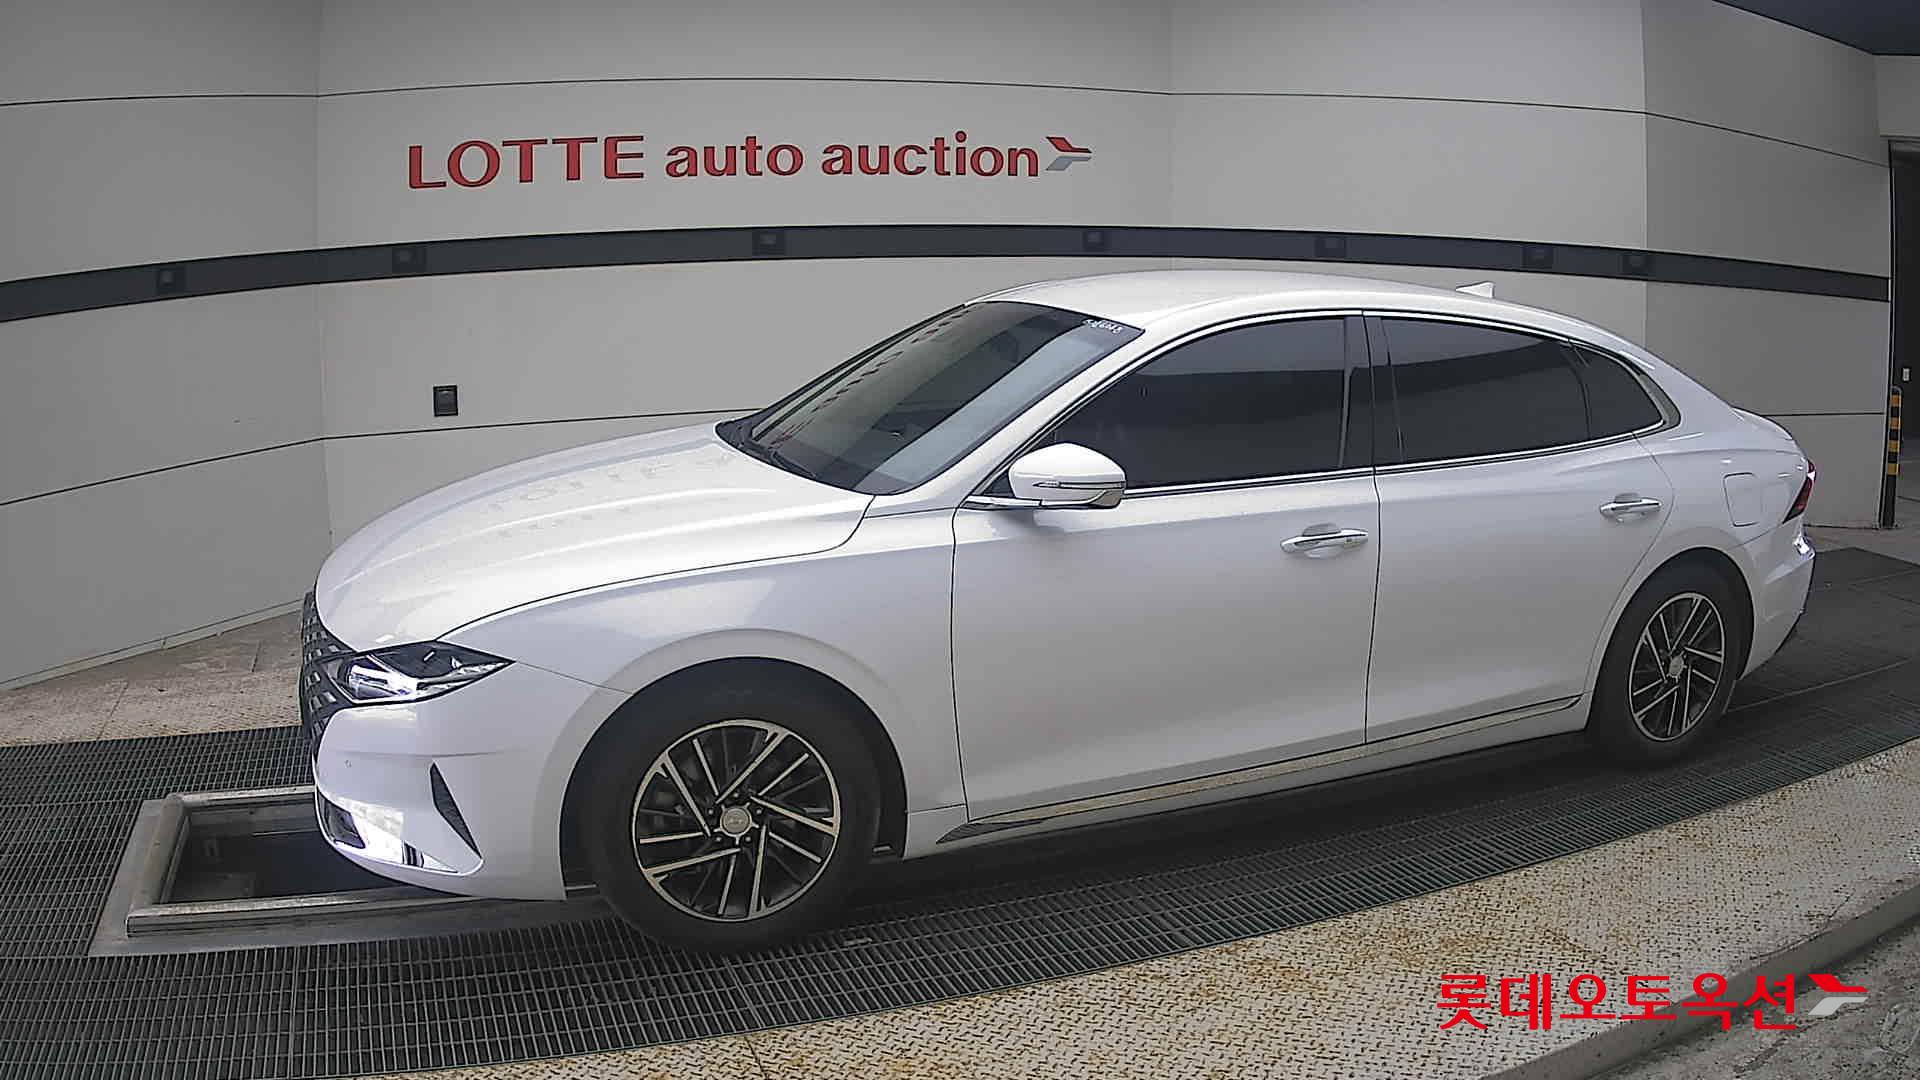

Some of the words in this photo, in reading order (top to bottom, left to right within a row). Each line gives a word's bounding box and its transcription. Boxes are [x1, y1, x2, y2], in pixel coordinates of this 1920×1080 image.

[408, 135, 645, 190] LOTTE
[665, 135, 804, 178] auto
[821, 131, 1041, 178] auction
